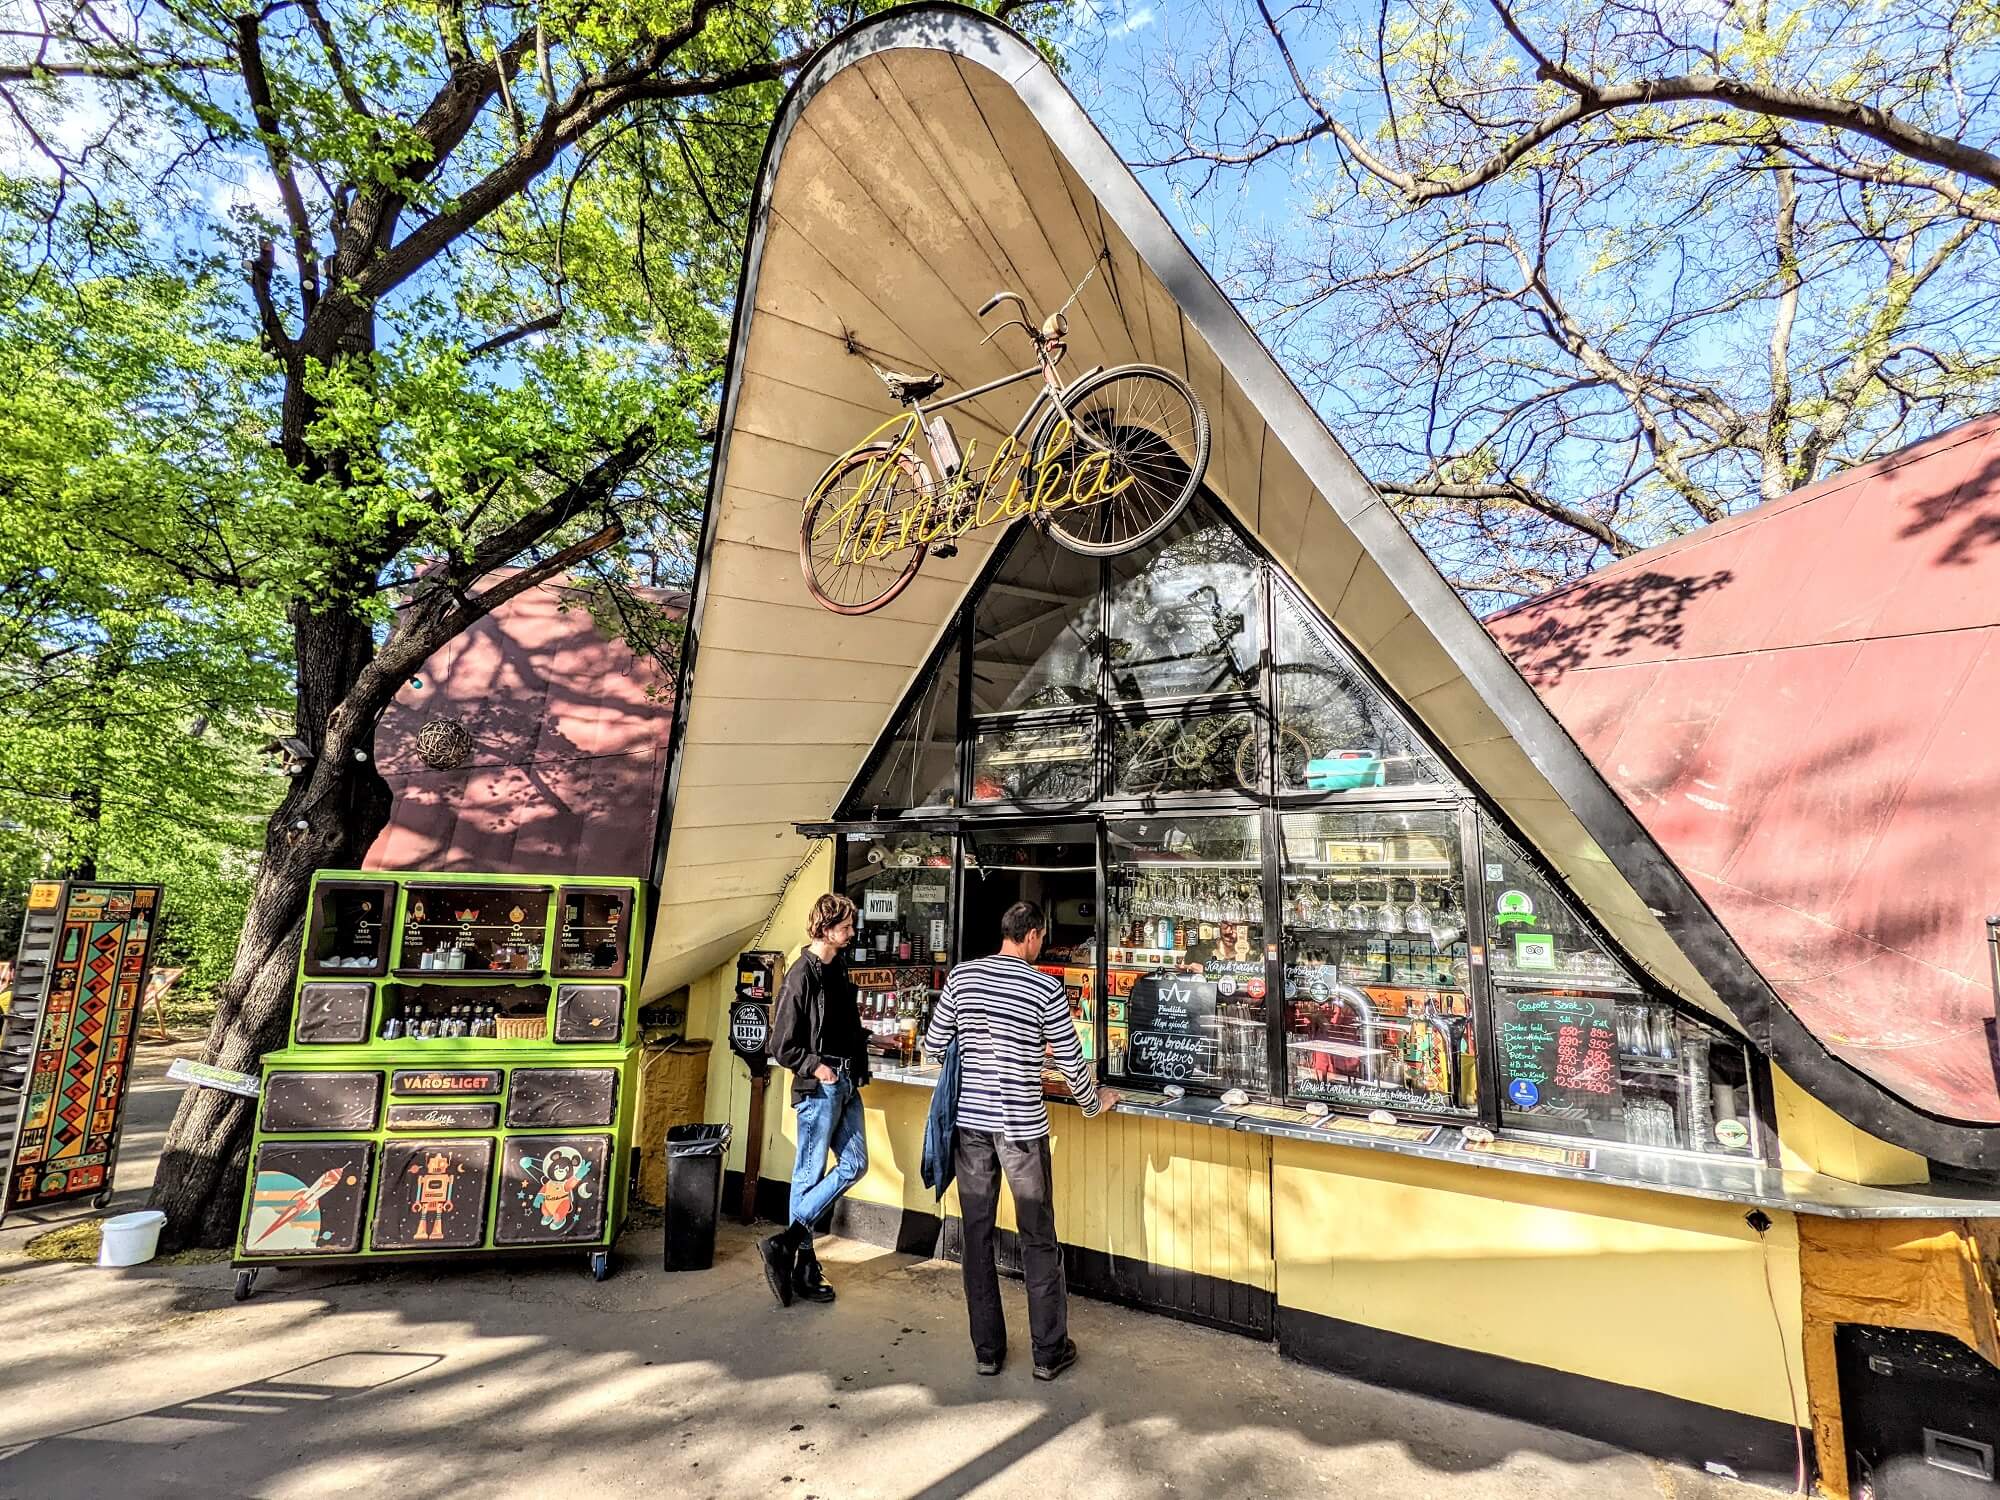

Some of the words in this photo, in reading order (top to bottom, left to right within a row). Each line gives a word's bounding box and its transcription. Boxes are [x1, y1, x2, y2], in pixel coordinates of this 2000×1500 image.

[870, 899, 893, 913] NYITVA
[736, 1026, 763, 1039] BBQ
[403, 1075, 488, 1089] VÁROSLIGET
